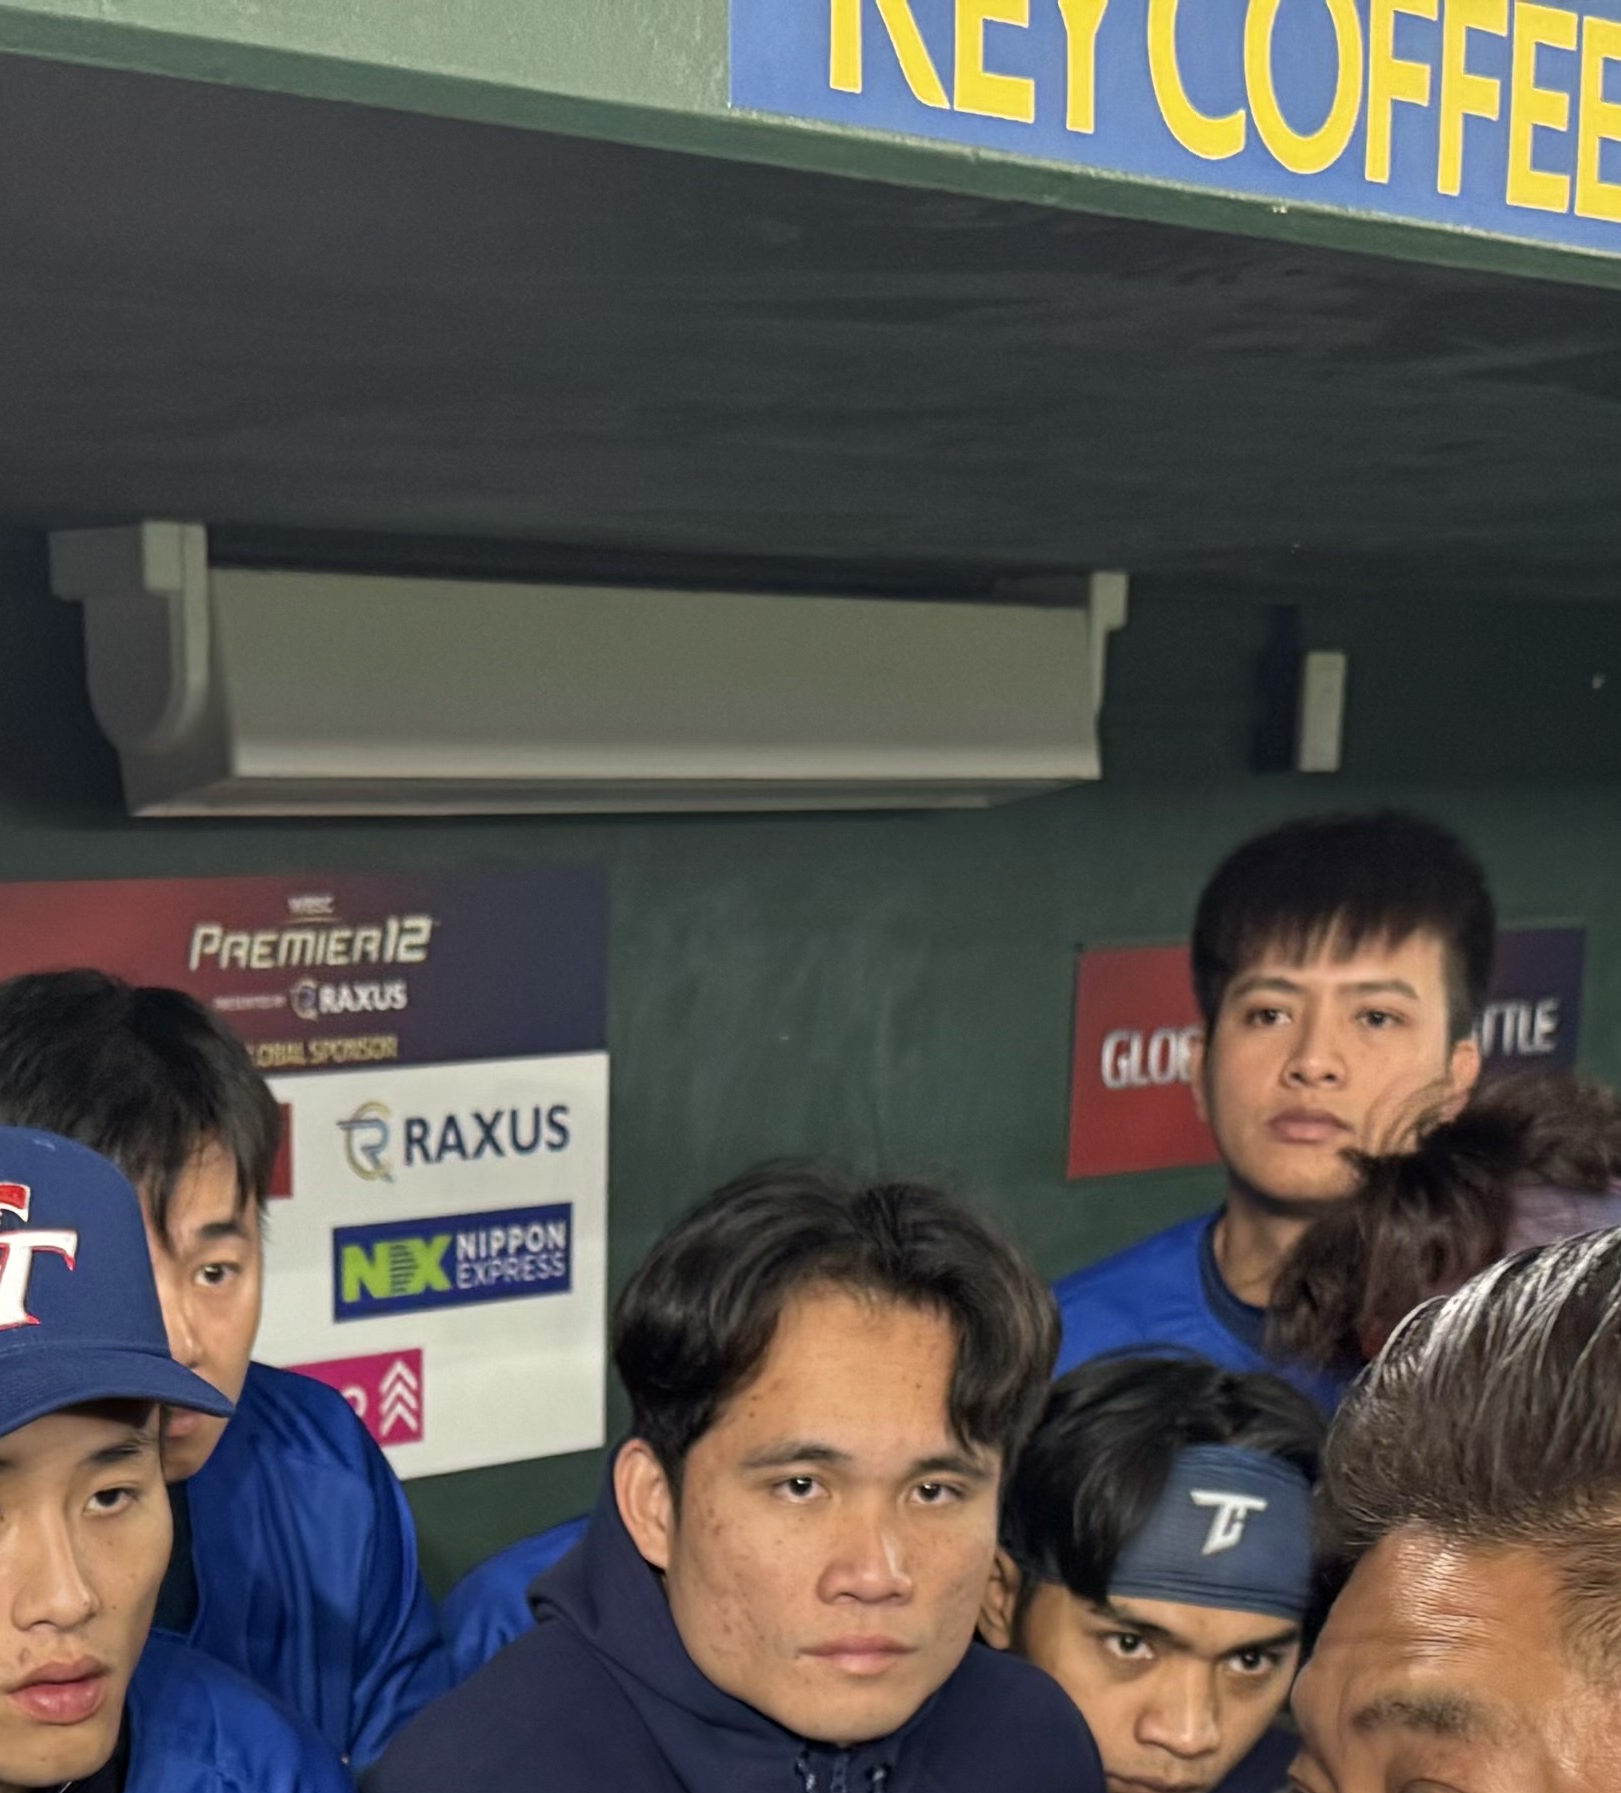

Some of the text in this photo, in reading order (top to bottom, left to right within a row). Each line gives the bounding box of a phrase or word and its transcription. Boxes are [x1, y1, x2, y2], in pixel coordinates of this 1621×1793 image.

[318, 979, 408, 1014] RAXUS
[309, 1034, 398, 1064] SPONSOR
[404, 1104, 570, 1167] RAXUS
[457, 1221, 568, 1260] NIPPON
[457, 1252, 566, 1289] EXPRESS
